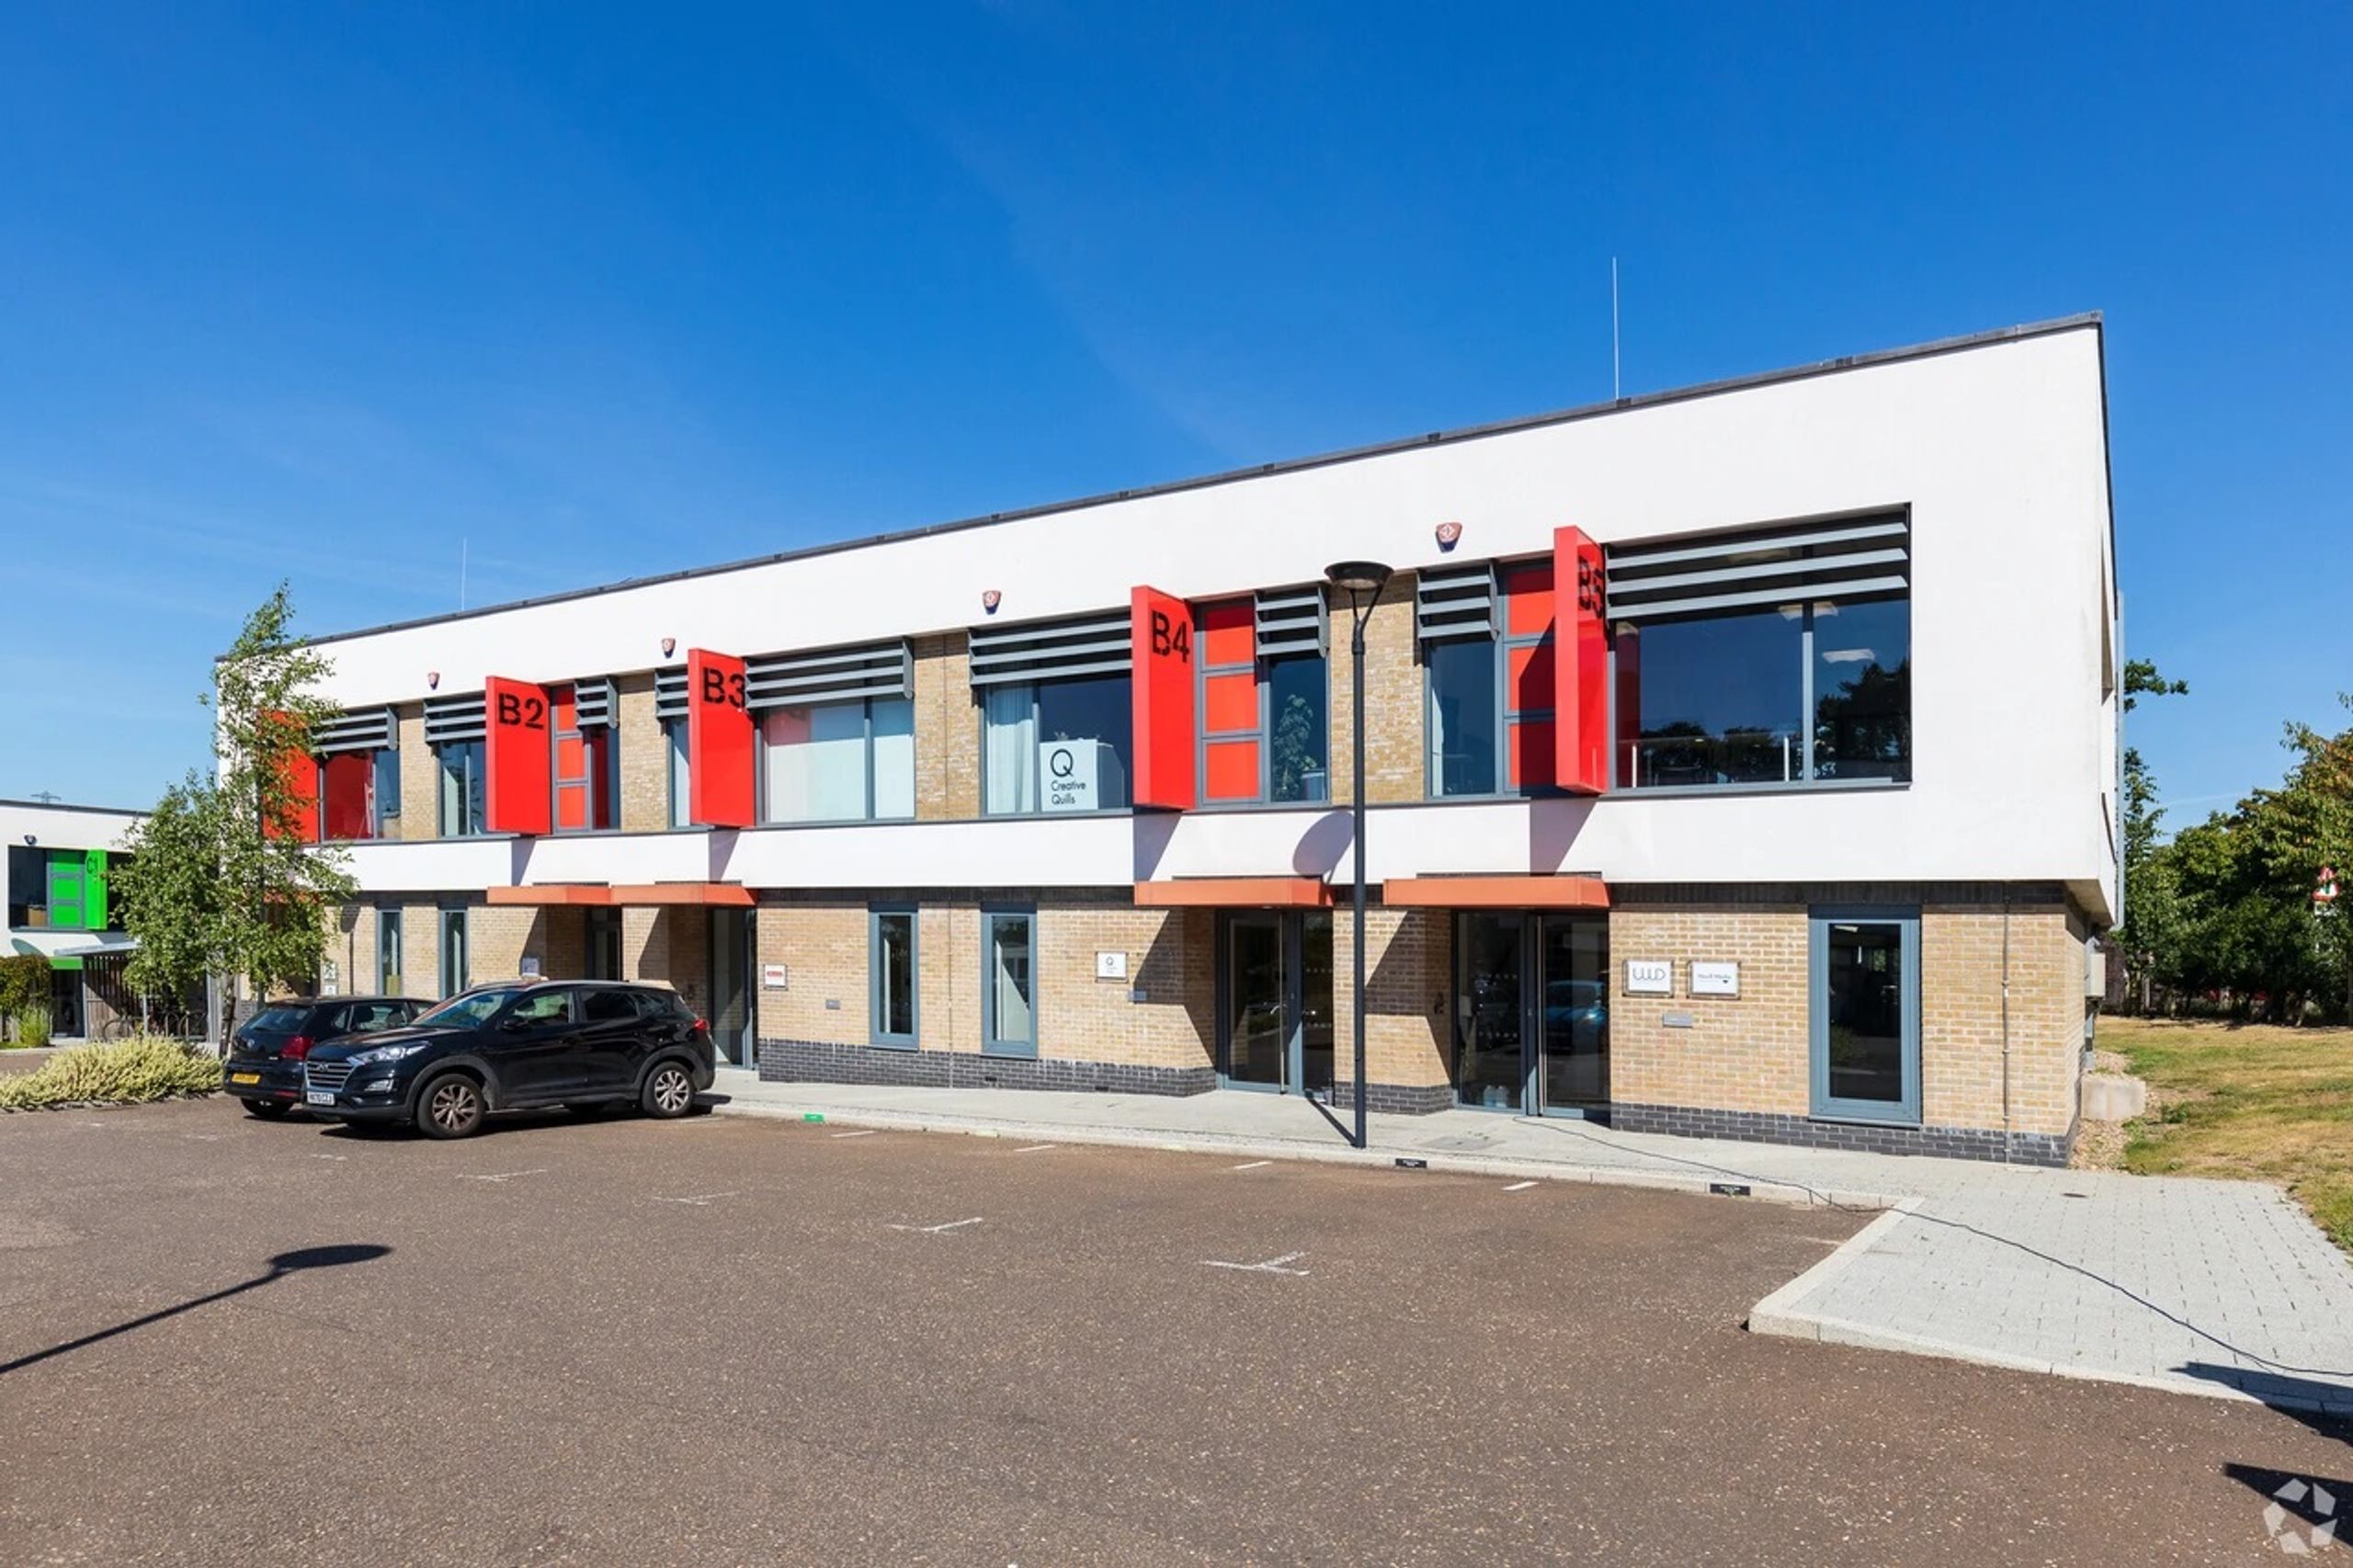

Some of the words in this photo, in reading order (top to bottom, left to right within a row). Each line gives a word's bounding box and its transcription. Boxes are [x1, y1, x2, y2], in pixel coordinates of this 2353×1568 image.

[1578, 555, 1605, 619] B5
[1152, 609, 1190, 664] B4
[703, 666, 745, 709] B3
[498, 692, 544, 730] B2
[1051, 748, 1074, 778] Q
[1051, 779, 1086, 791] Creative
[1051, 793, 1075, 805] Quills
